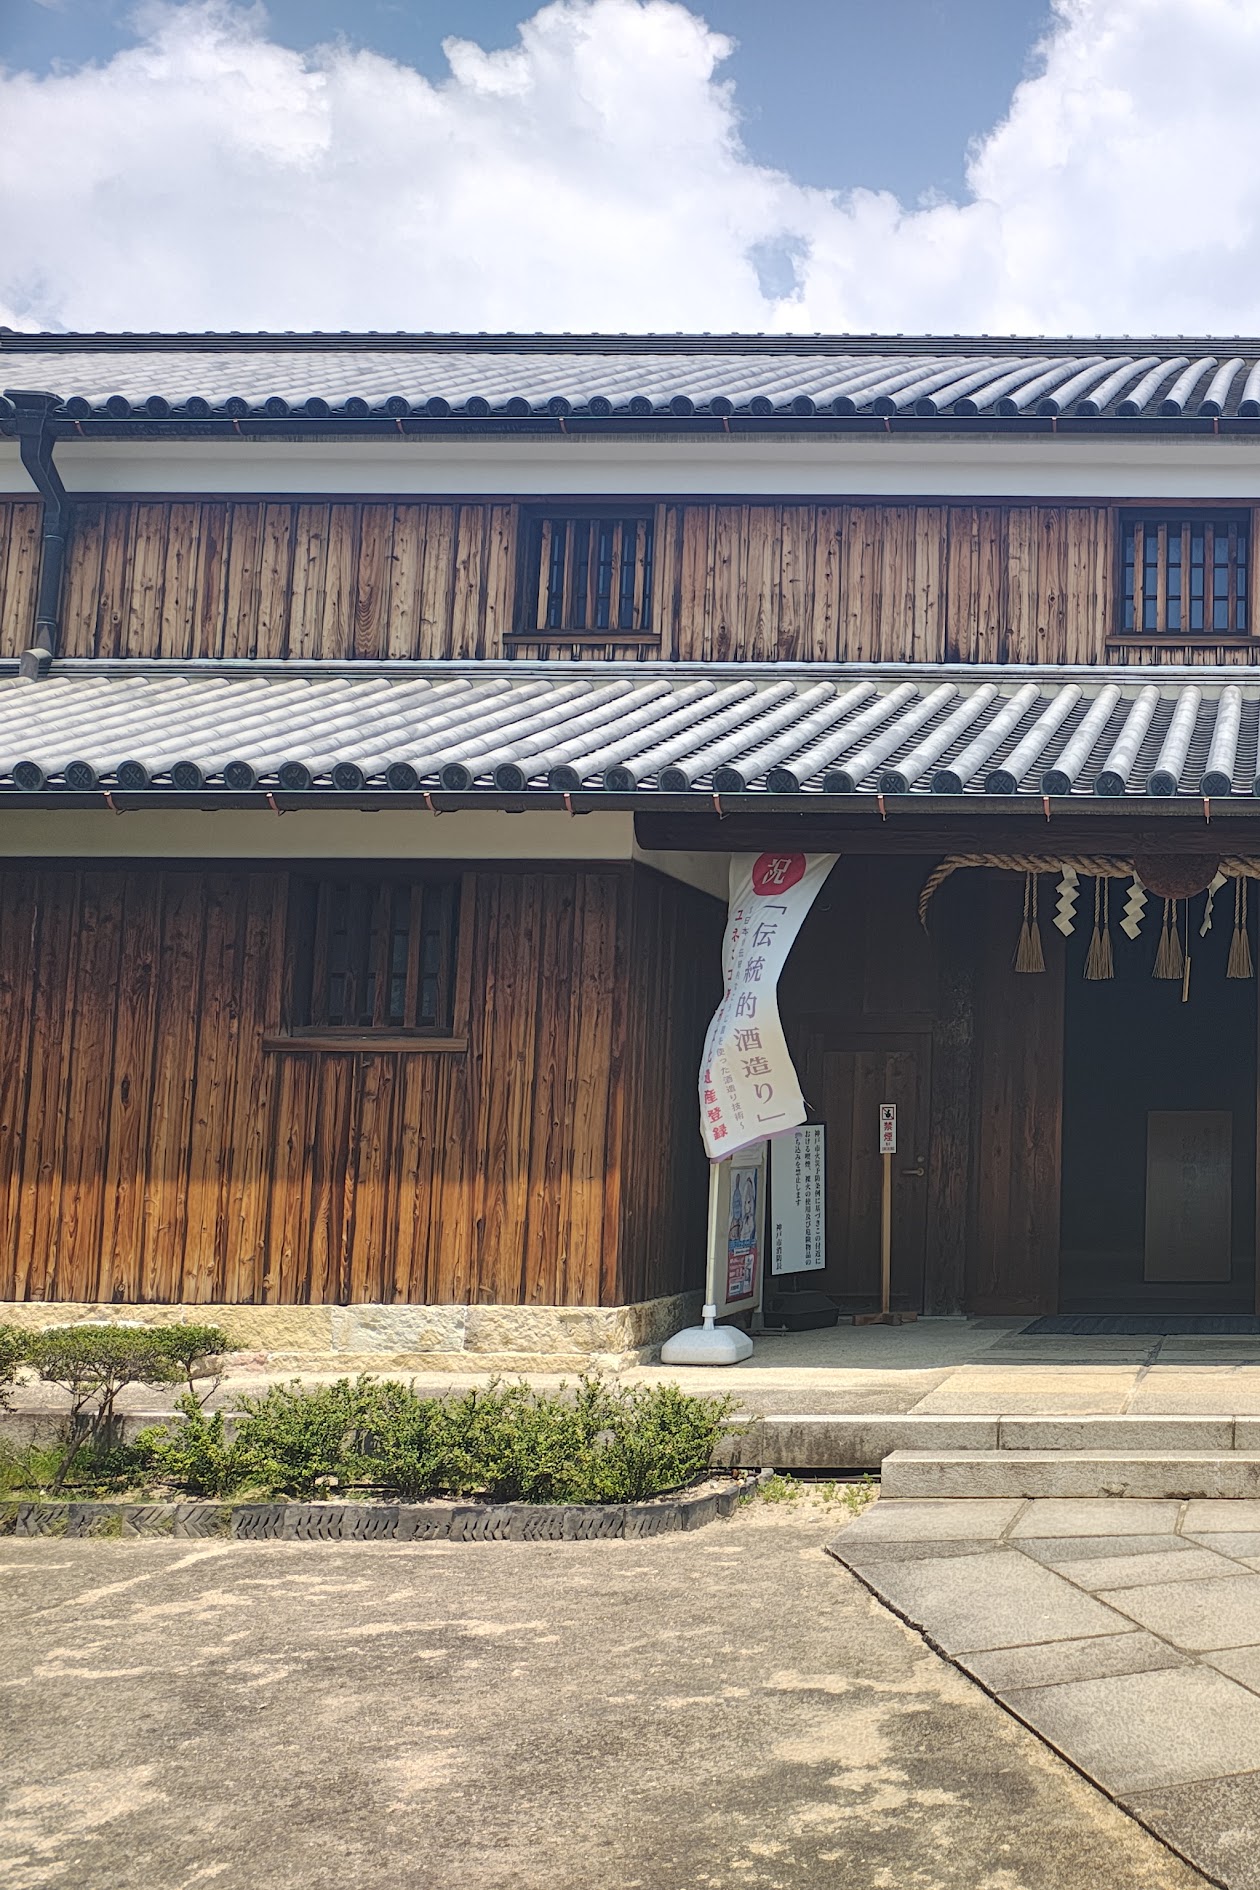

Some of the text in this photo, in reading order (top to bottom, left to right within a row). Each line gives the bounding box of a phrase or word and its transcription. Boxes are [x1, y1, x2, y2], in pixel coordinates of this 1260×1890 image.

[733, 905, 787, 1122] 「伝統的酒造り」
[883, 1121, 893, 1142] 禁煙
